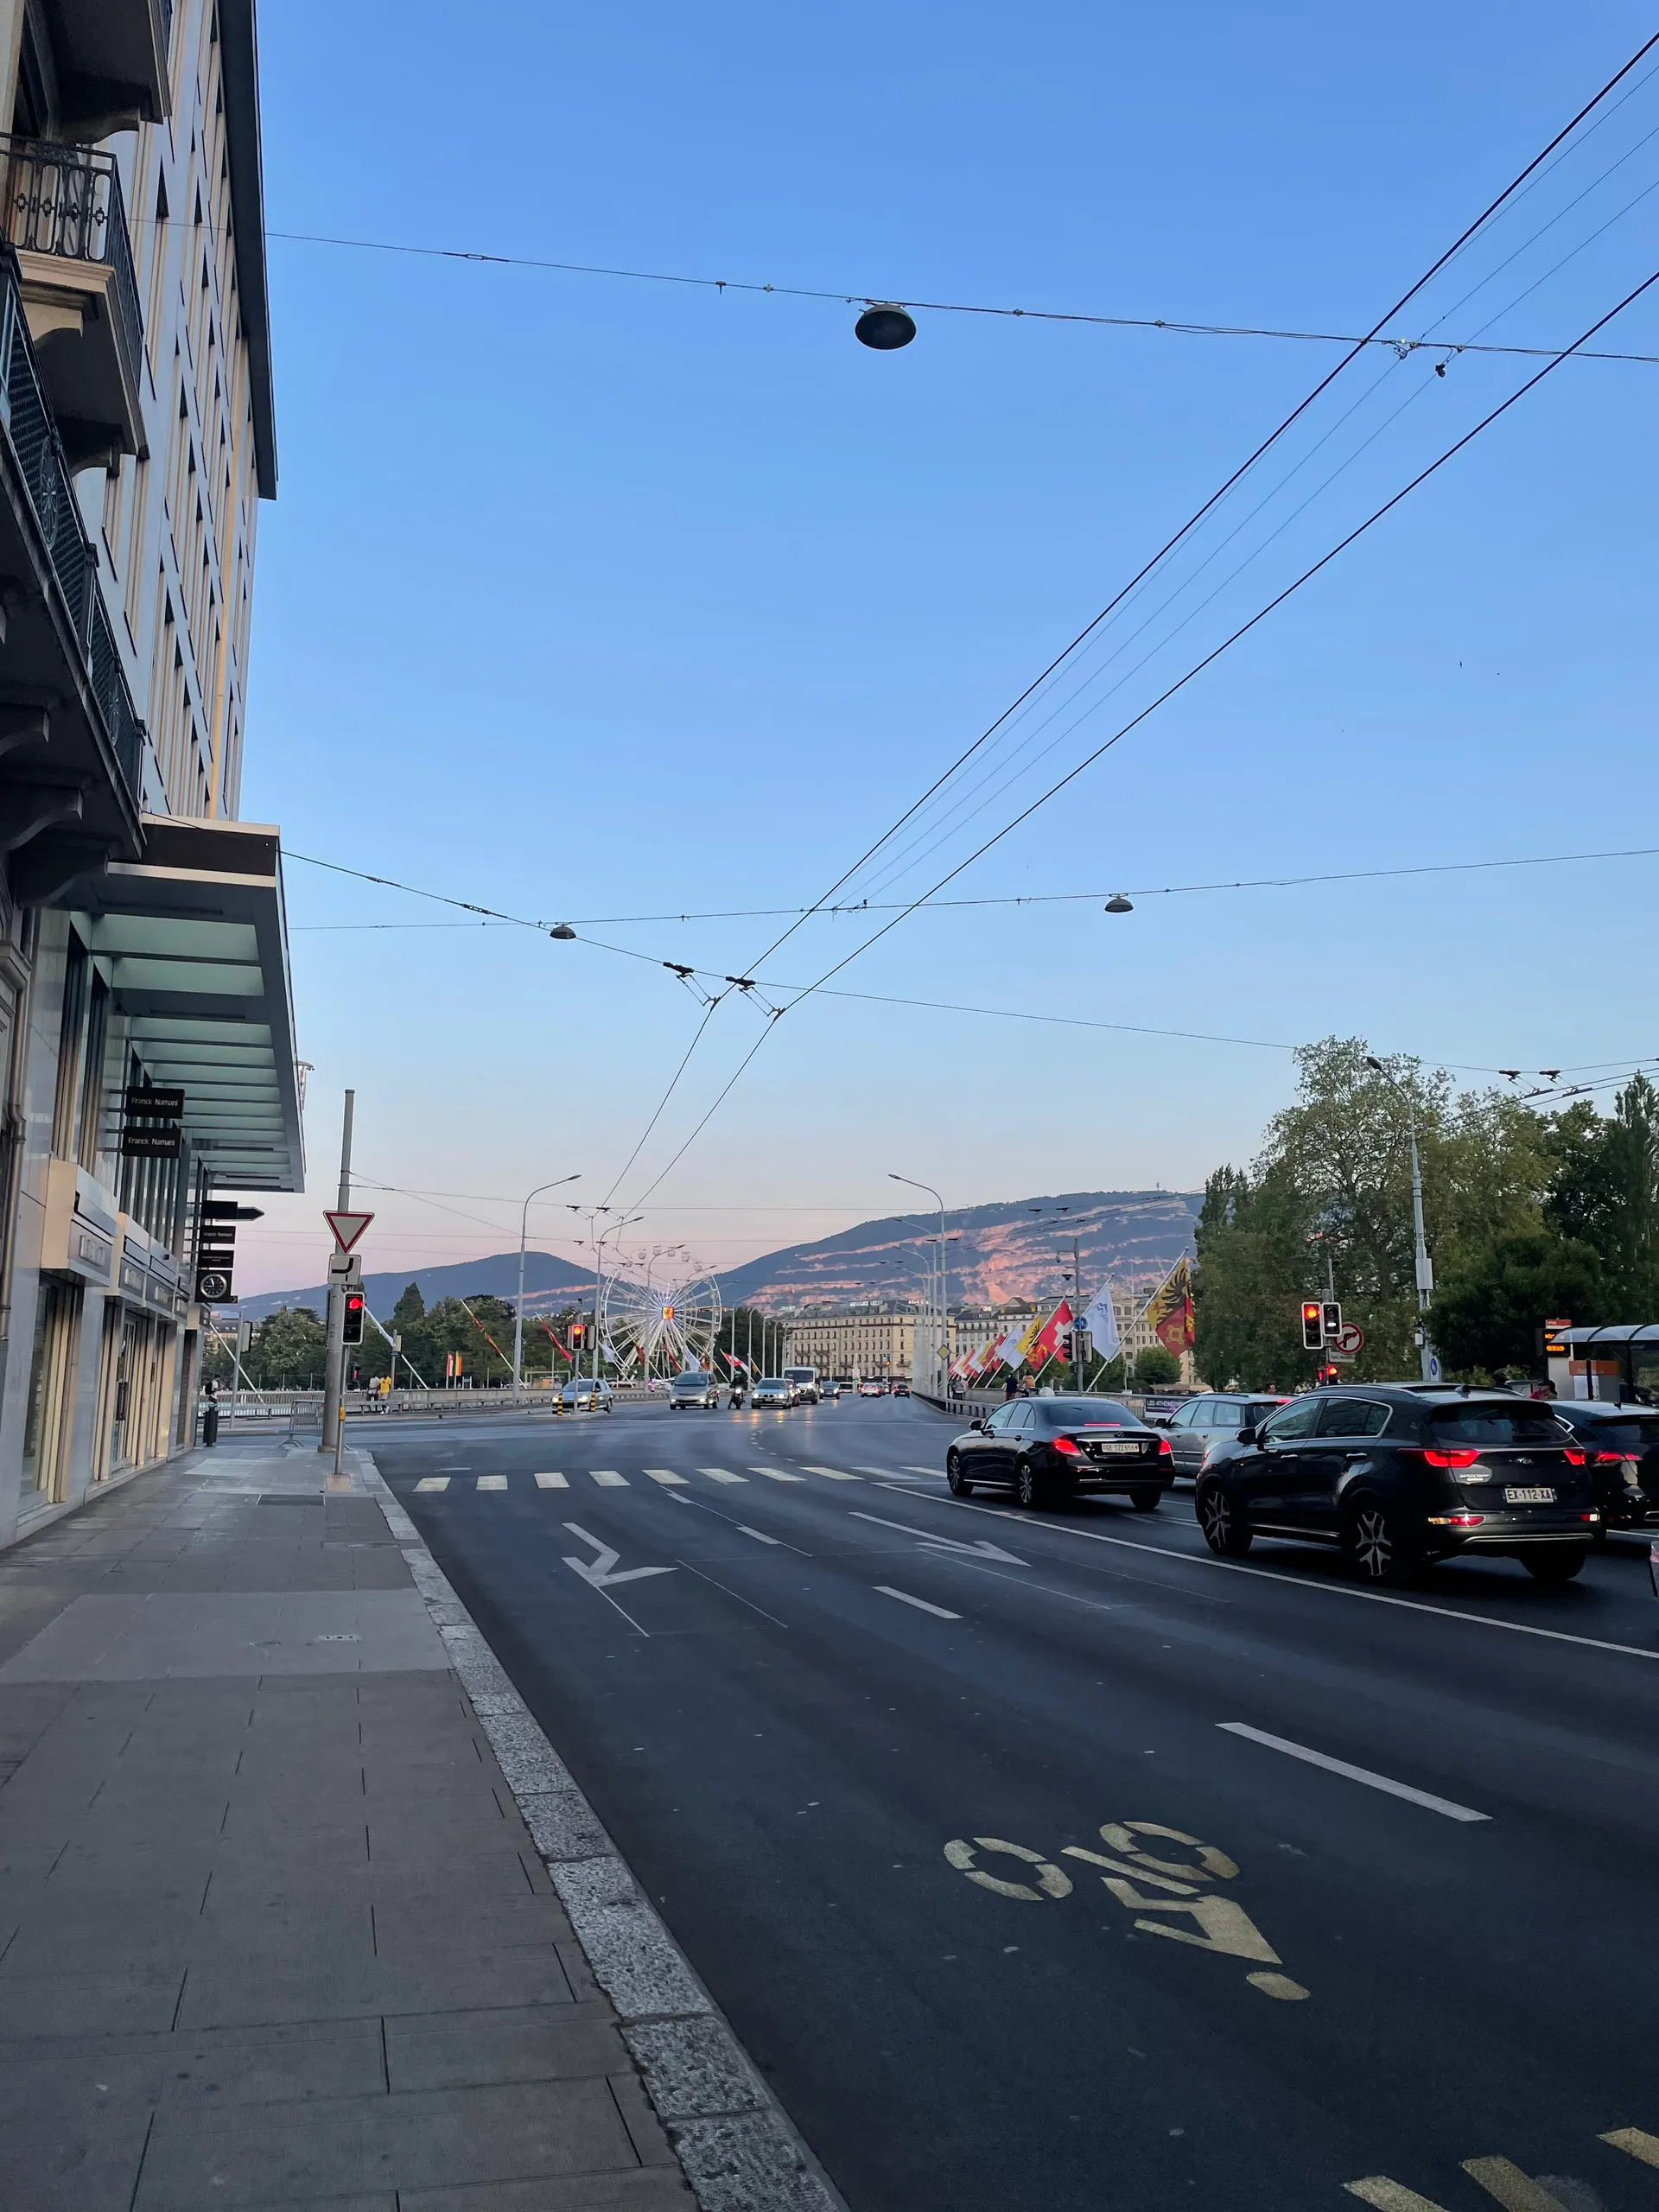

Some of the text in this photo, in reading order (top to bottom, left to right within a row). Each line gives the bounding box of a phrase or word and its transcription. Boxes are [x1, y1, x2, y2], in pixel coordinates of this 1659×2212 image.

[131, 1096, 179, 1107] Franck Namani
[128, 1136, 175, 1147] Franck Namani
[1507, 1489, 1552, 1500] EX-112-XA
